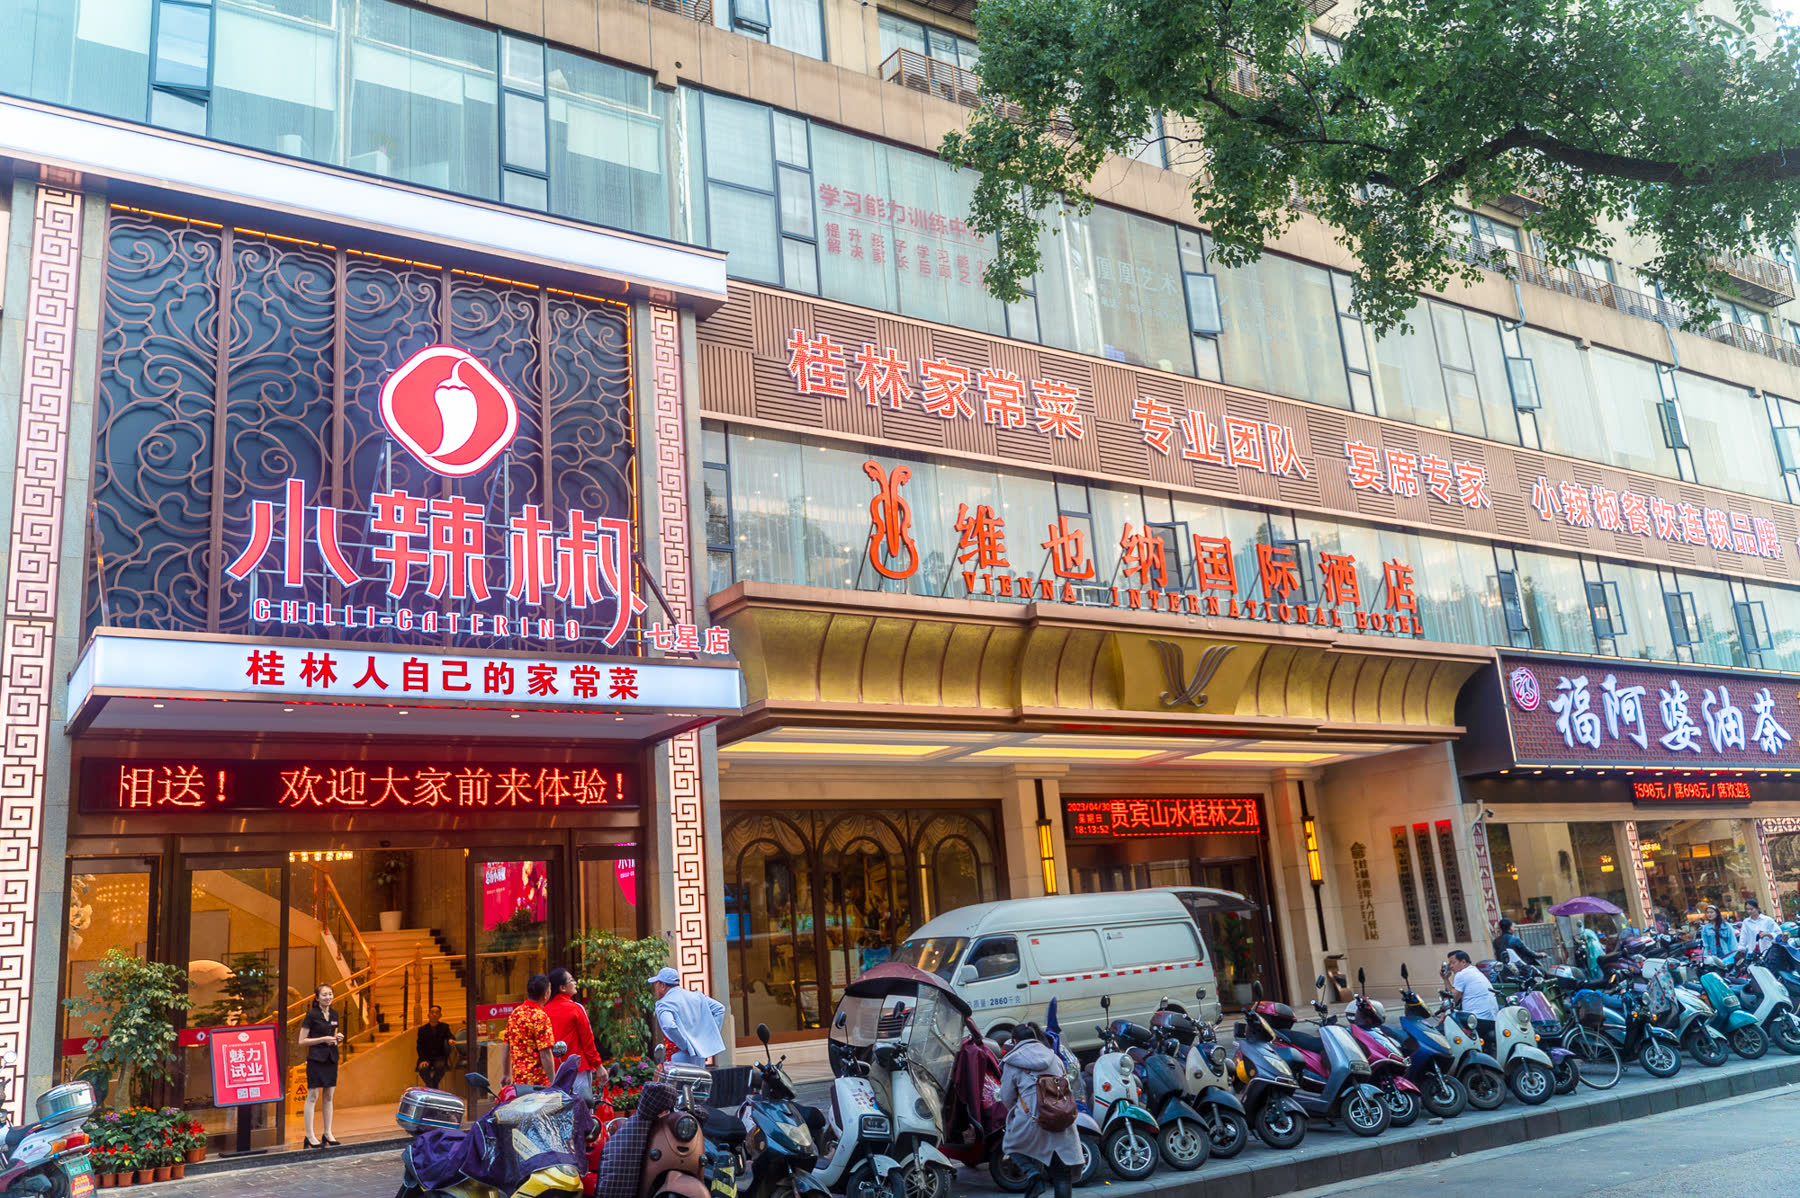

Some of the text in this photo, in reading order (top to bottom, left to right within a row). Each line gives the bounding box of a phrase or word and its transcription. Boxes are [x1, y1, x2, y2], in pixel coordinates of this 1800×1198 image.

[787, 328, 1782, 559] 桂林家常菜 专业团队 宴席专家 小辣椒餐饮连锁品牌
[225, 477, 648, 649] 小辣椒
[954, 502, 1419, 615] 维也纳国际酒店
[962, 571, 1424, 635] VIENNA INTERNATIONAL HOTEL
[644, 622, 730, 655] 七星店
[246, 649, 640, 700] 桂林人自己的家常菜
[1547, 673, 1792, 756] 福阿婆油茶
[1067, 802, 1111, 812] 2023/04/30
[1077, 813, 1103, 824] 星期日
[1074, 825, 1110, 834] 18:13:52
[228, 1047, 262, 1064] 魅力
[230, 1062, 264, 1078] 试业
